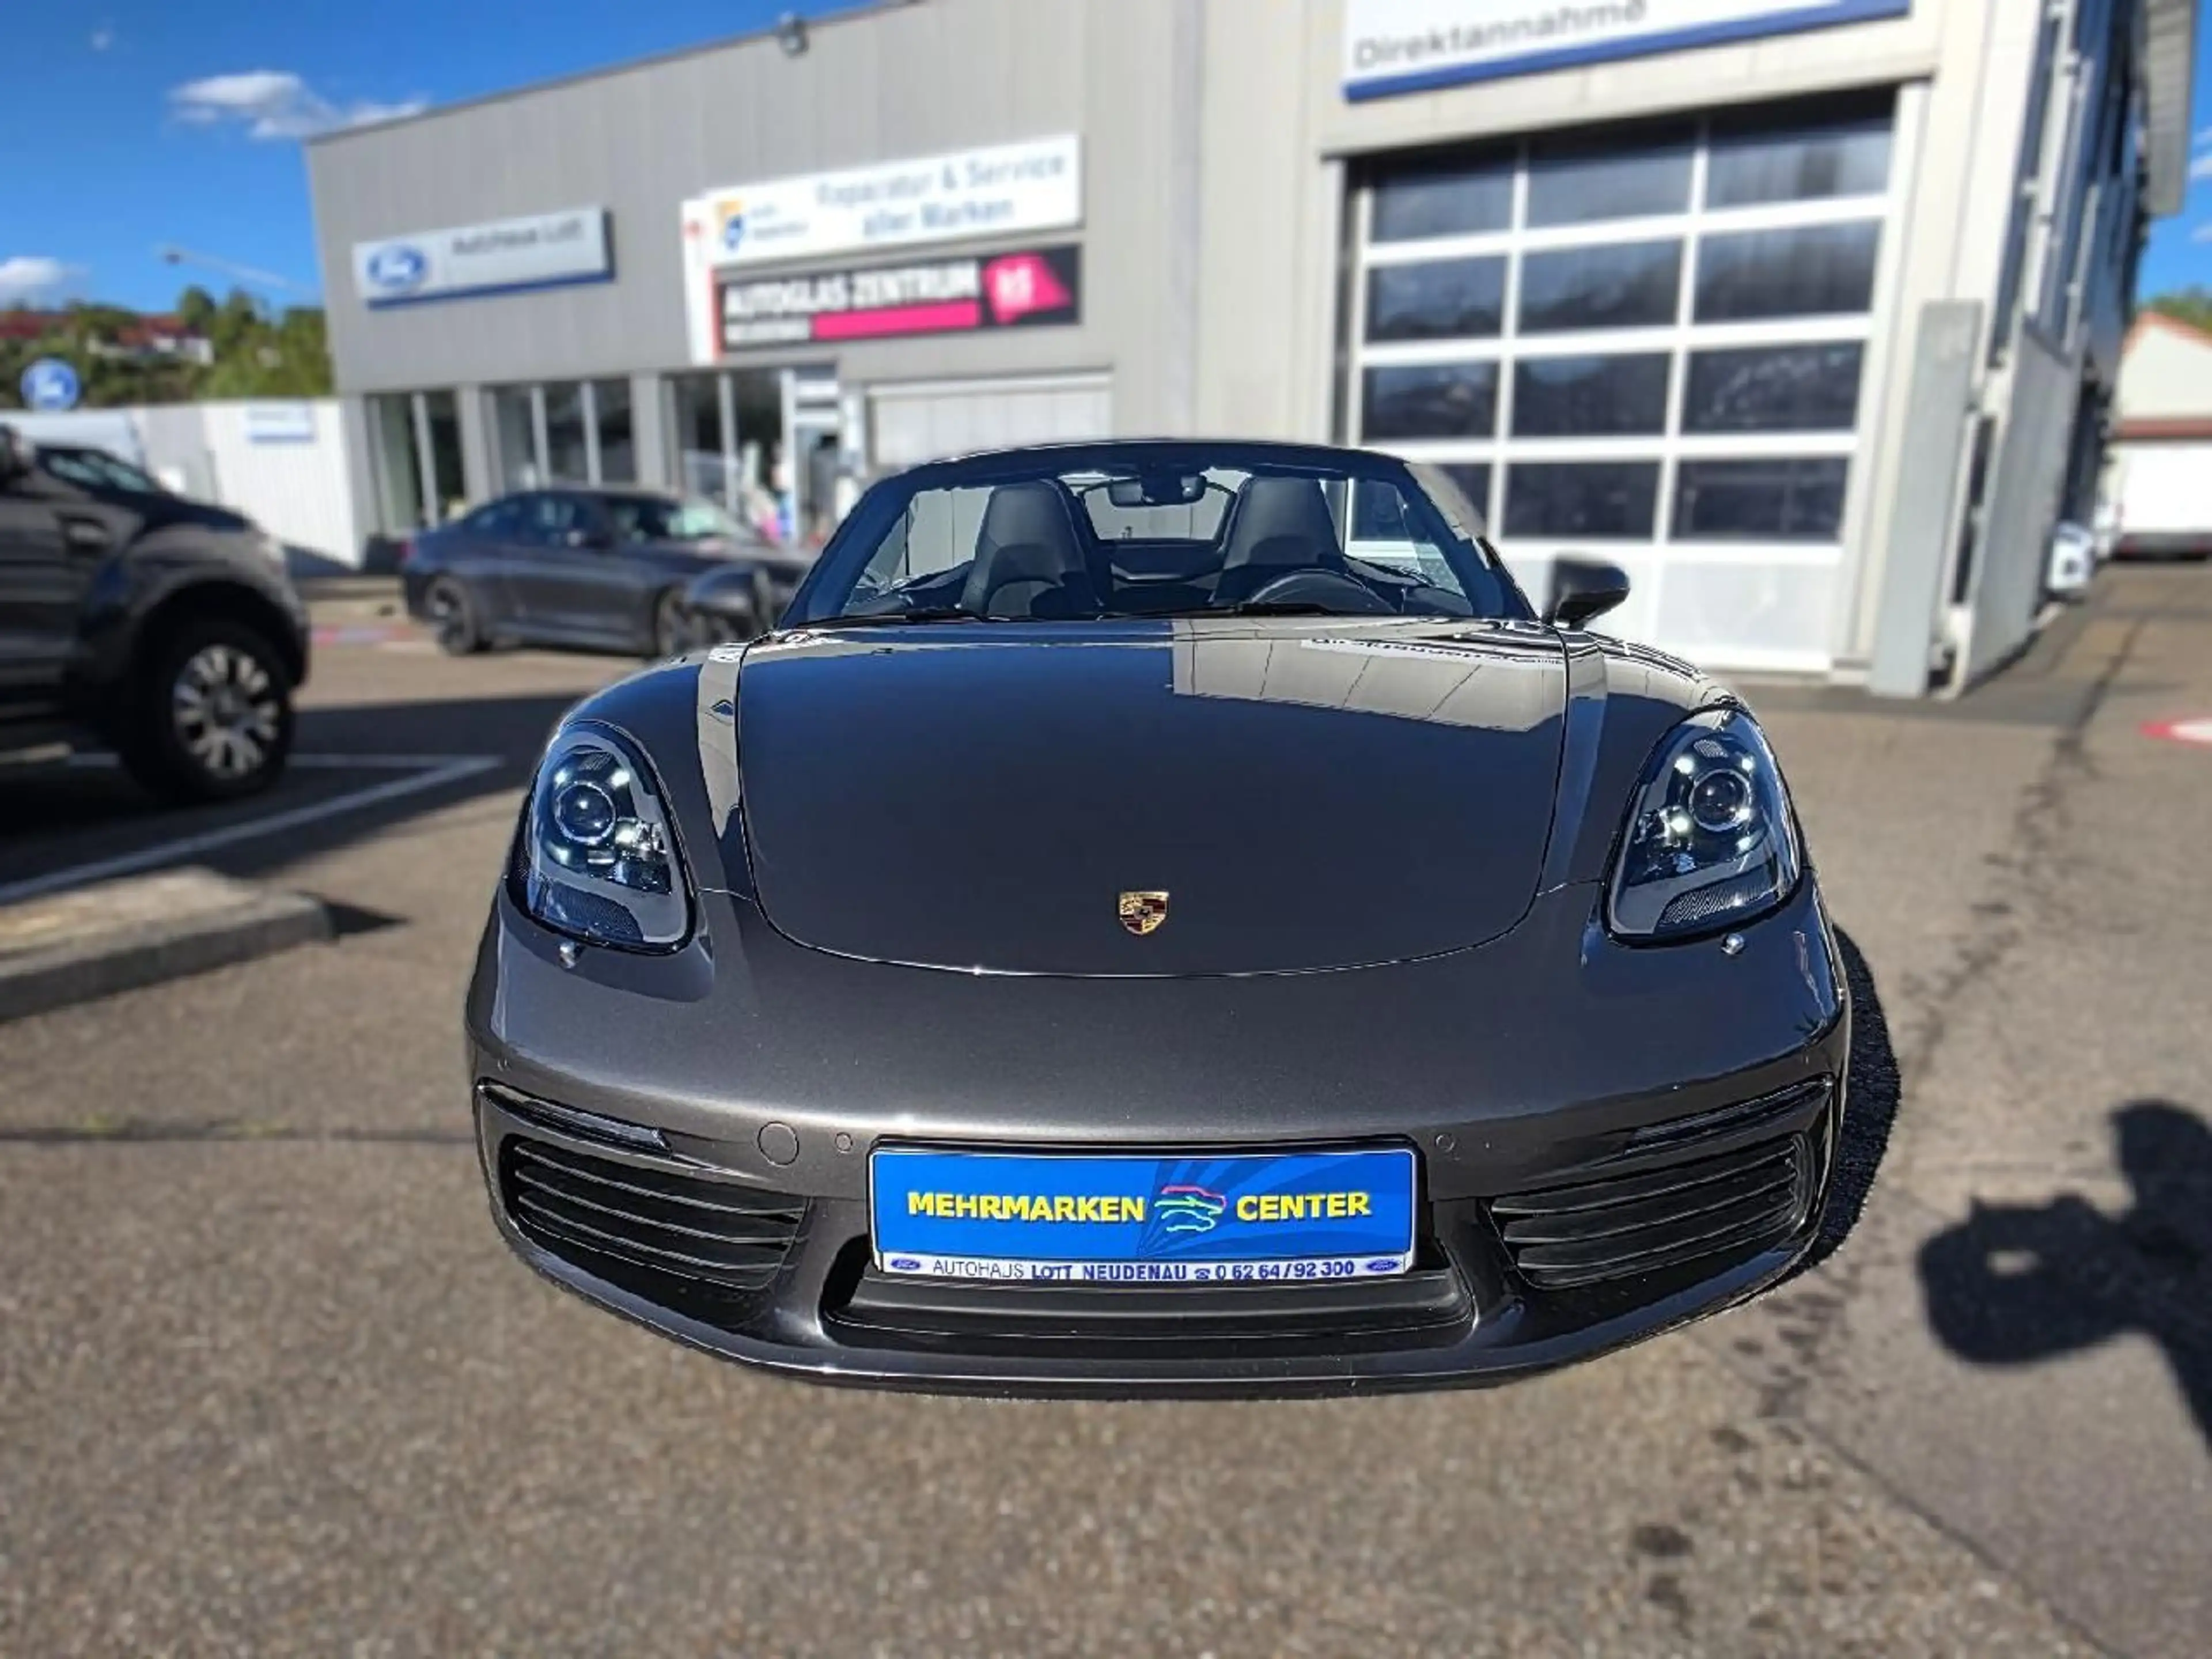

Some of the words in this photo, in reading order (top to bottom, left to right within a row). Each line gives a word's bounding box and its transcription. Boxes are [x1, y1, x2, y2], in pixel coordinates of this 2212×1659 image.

[907, 1191, 1146, 1224] MEHRMARKEN
[1236, 1192, 1372, 1222] CENTER
[1031, 1264, 1071, 1280] LOTT
[1083, 1265, 1187, 1280] NEUDENAU
